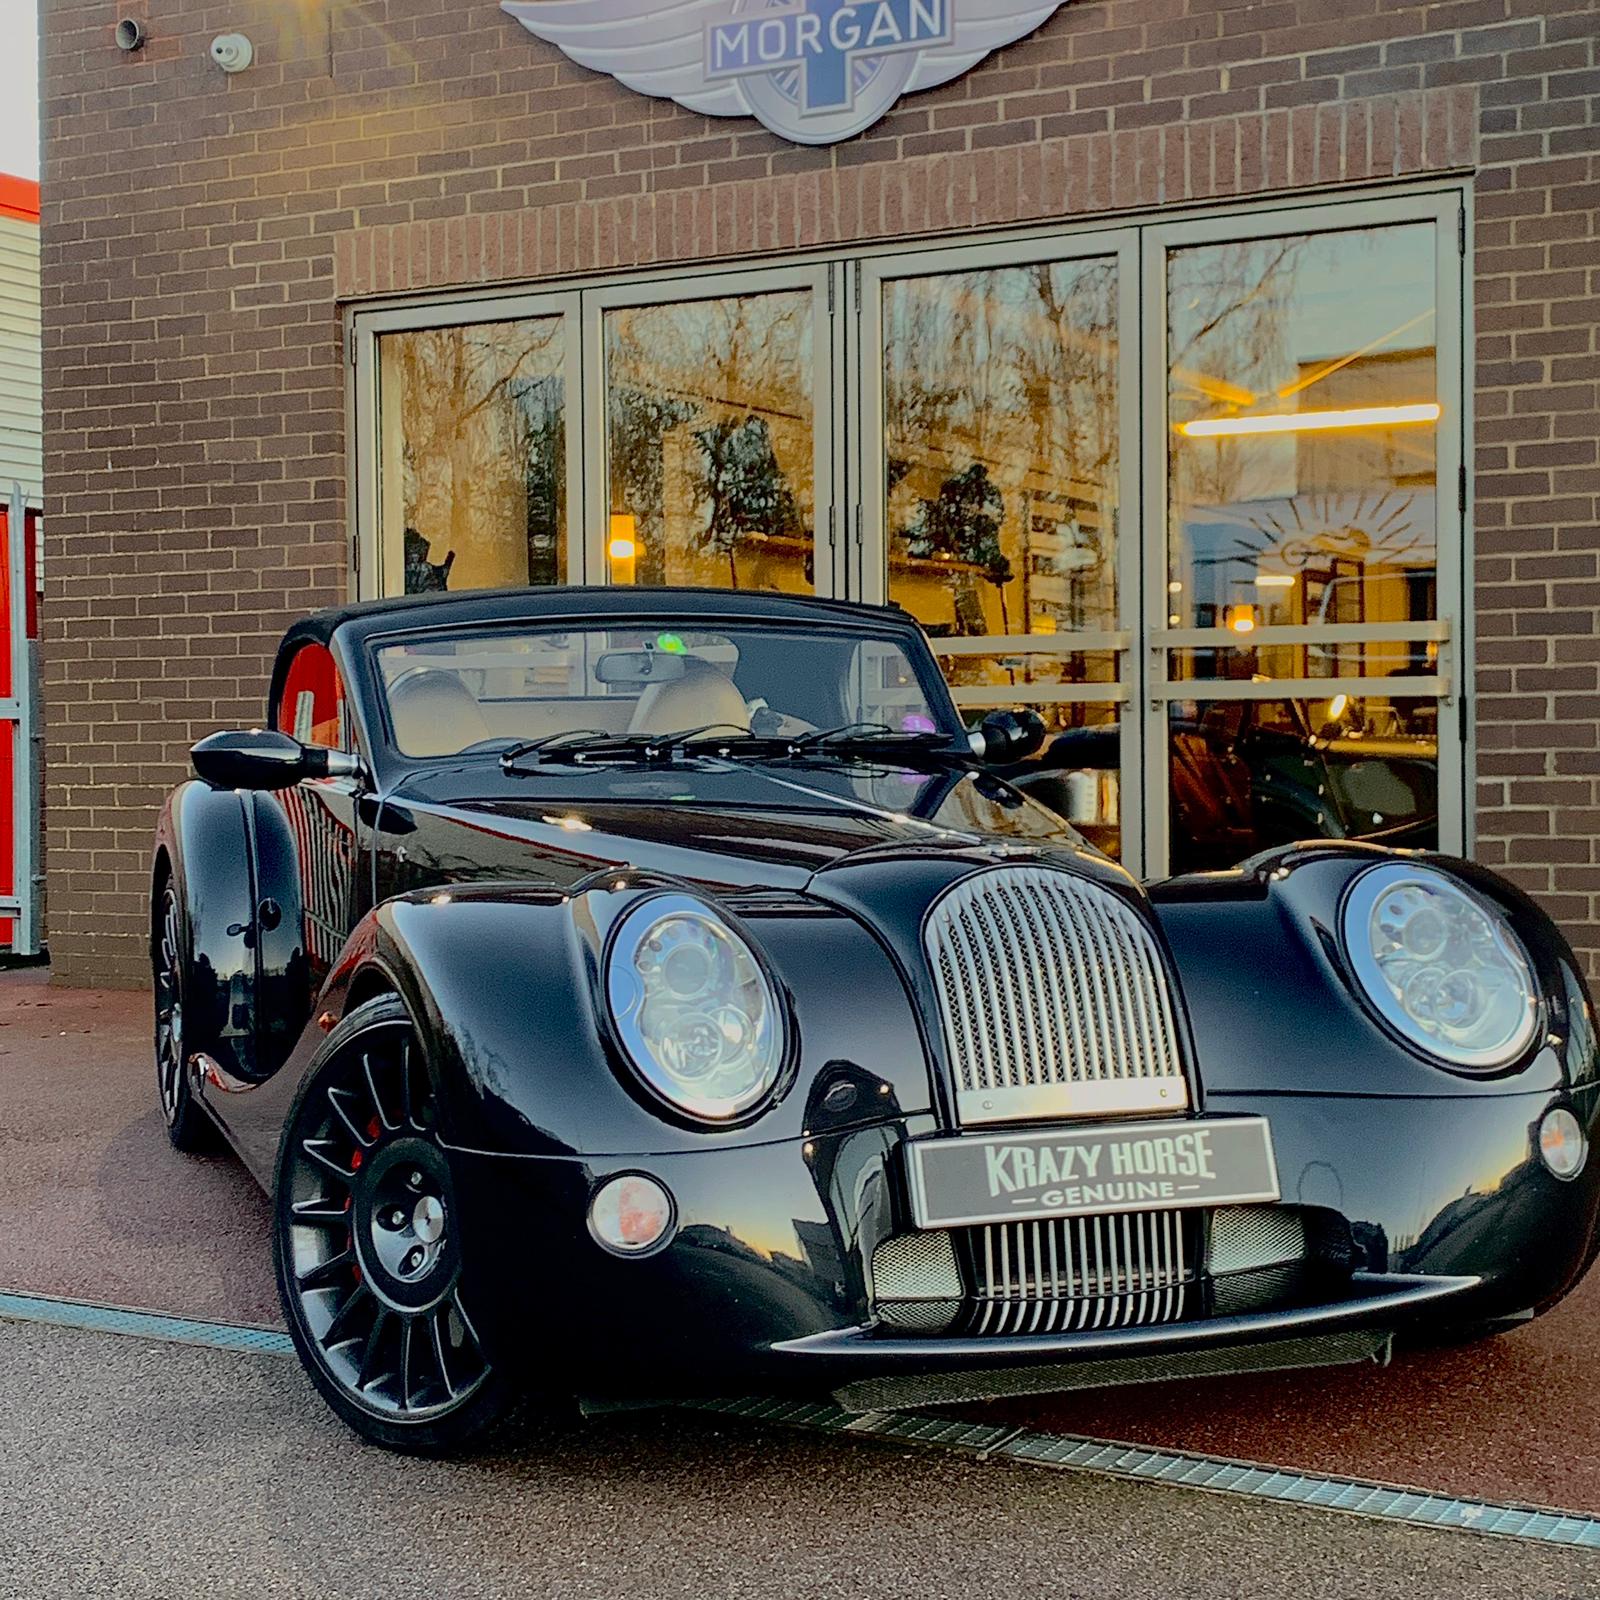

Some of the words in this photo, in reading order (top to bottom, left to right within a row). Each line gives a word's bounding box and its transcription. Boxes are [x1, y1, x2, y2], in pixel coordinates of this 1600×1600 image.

[715, 0, 941, 69] MORGAN
[985, 1144, 1102, 1197] KRAZY
[1110, 1130, 1216, 1179] HORSE
[1041, 1181, 1175, 1207] GENUINE
